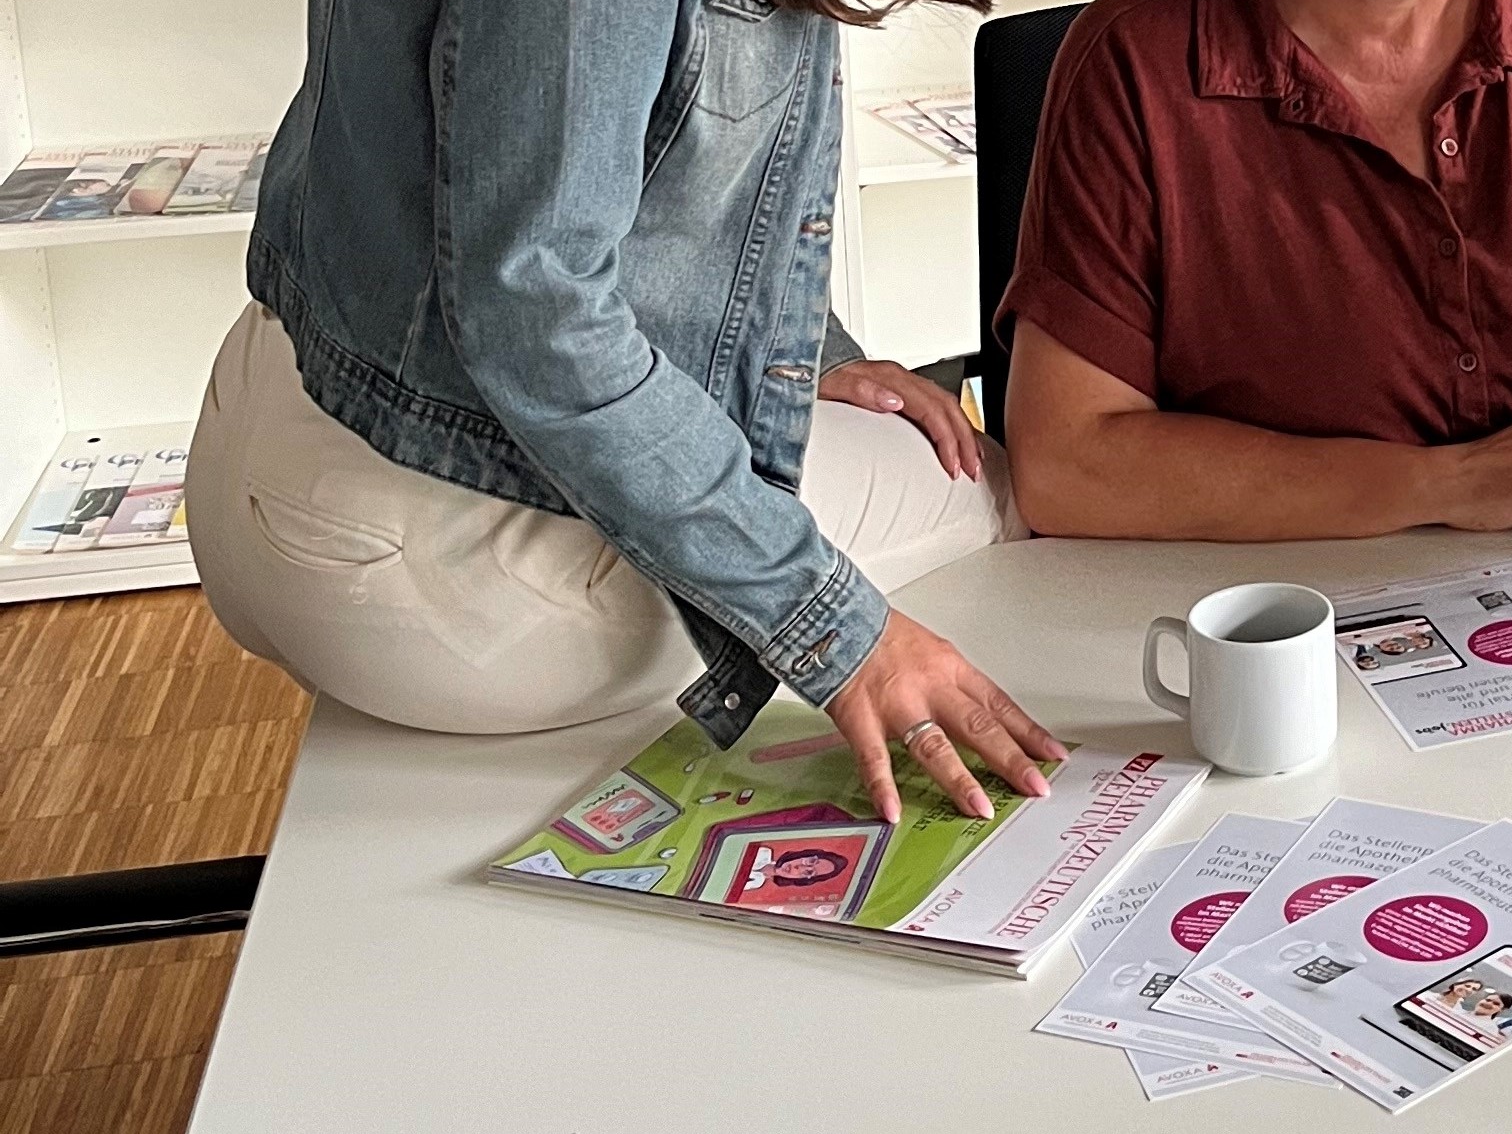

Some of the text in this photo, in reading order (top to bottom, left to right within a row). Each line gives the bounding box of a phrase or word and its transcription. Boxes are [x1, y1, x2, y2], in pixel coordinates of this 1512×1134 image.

[1060, 771, 1141, 841] ZEITUNG
[1328, 829, 1359, 842] Das
[1217, 845, 1248, 858] Das
[1318, 840, 1345, 852] die
[997, 775, 1168, 939] PHARMAZEUTISCHE
[1207, 856, 1234, 867] die
[1449, 857, 1472, 872] die
[1464, 849, 1492, 867] Das
[923, 888, 964, 924] AVOXA
